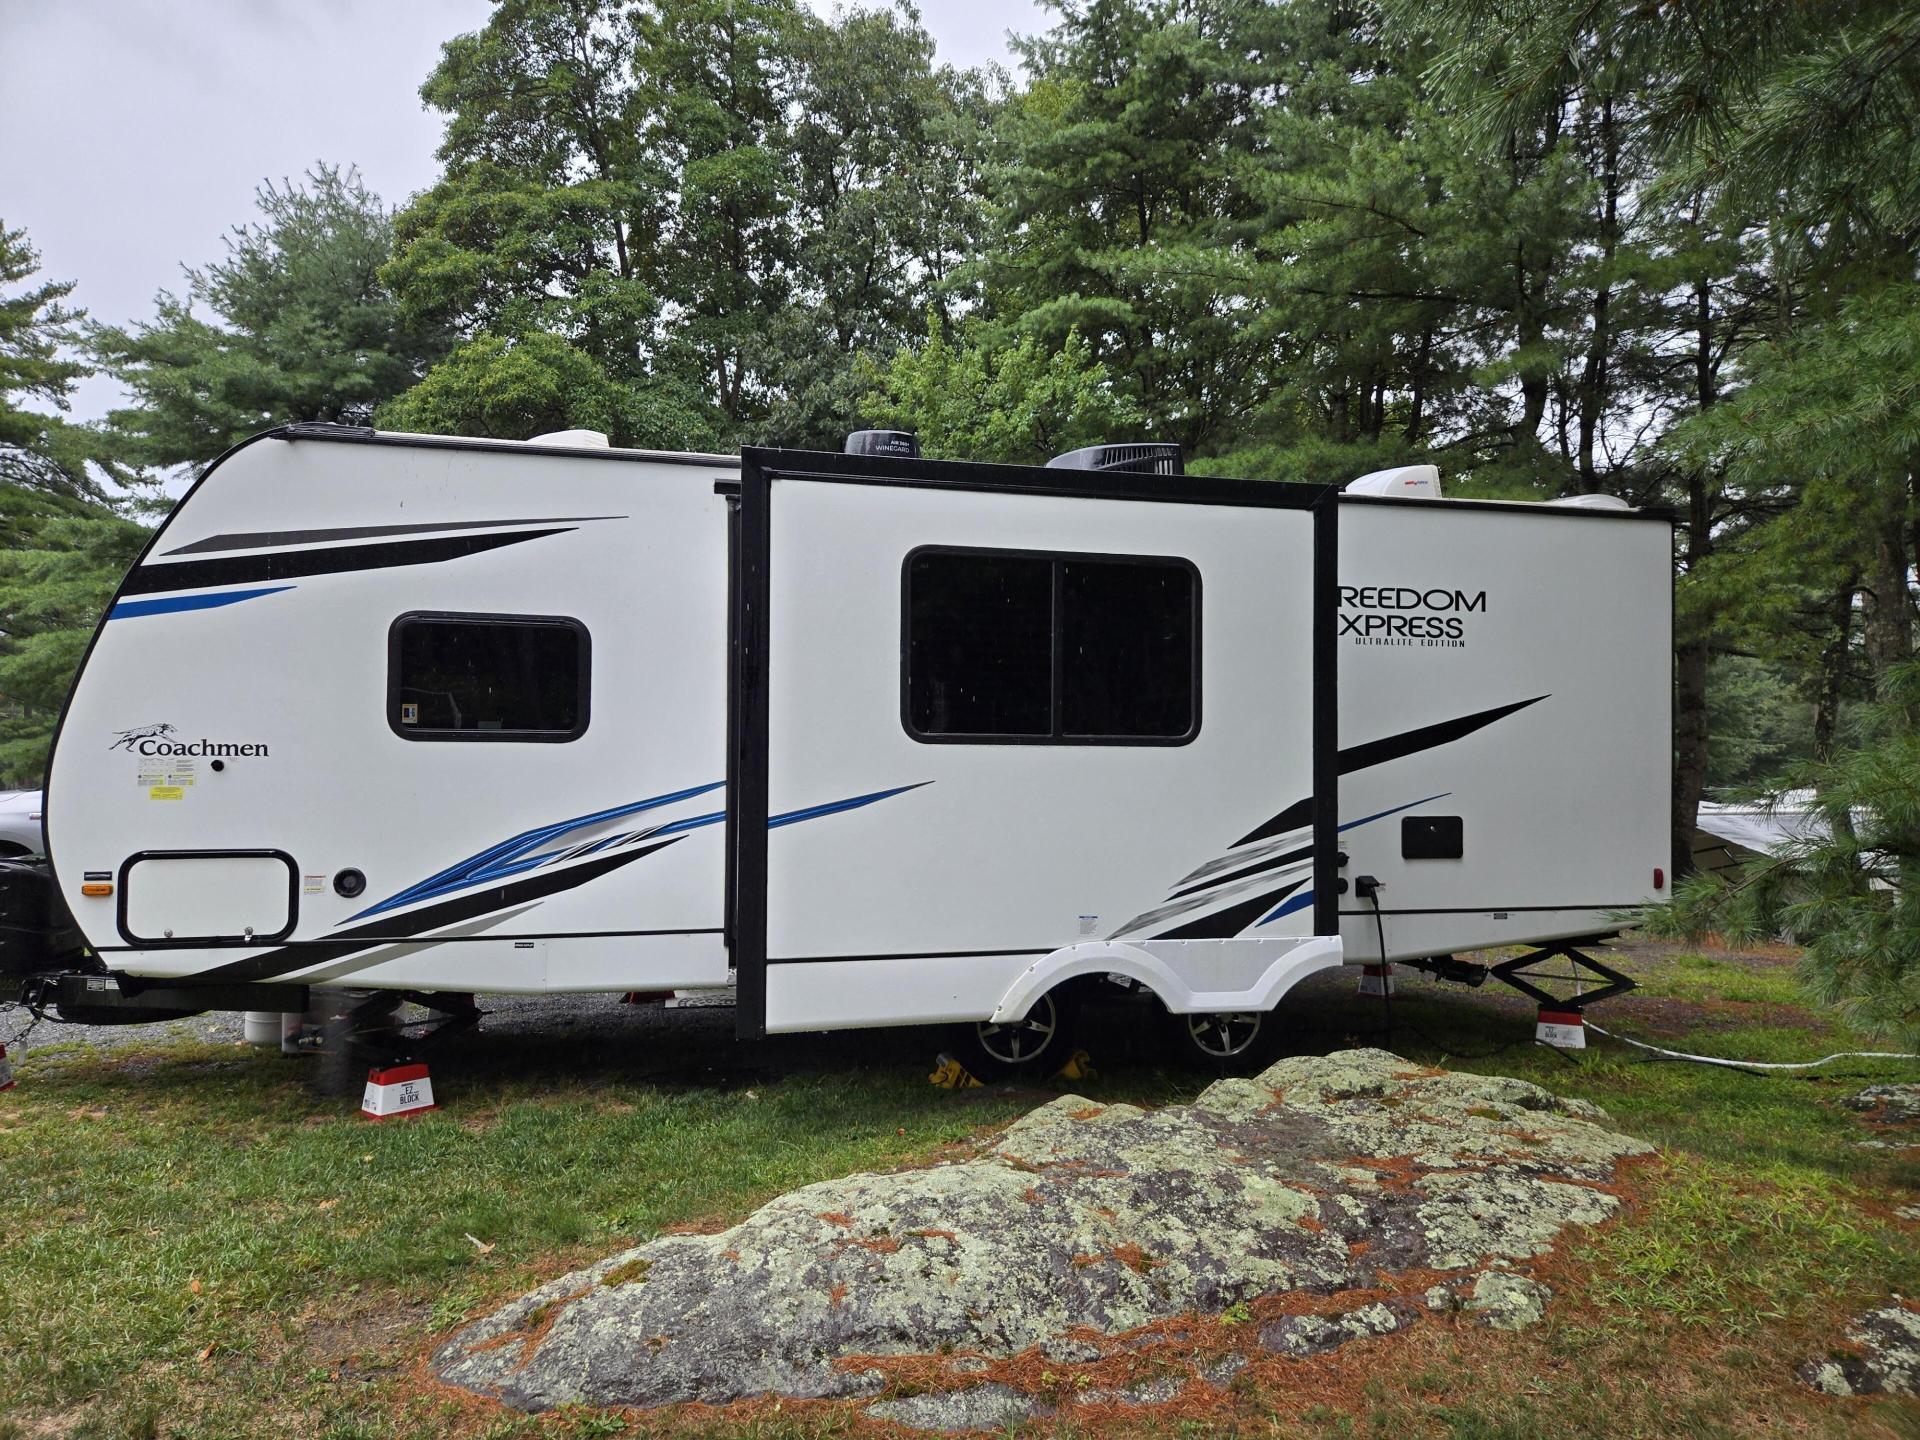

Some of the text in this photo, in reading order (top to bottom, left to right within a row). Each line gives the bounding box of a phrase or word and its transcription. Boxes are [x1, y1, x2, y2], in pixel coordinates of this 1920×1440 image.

[876, 445, 910, 453] WINEGARD
[1337, 586, 1486, 612] REEDOM
[1338, 614, 1464, 639] XPRESS
[1355, 637, 1465, 648] ULTRALITE EDITION
[139, 738, 269, 757] Coachmen
[405, 1086, 413, 1095] EZ
[399, 1094, 420, 1105] BLOCK
